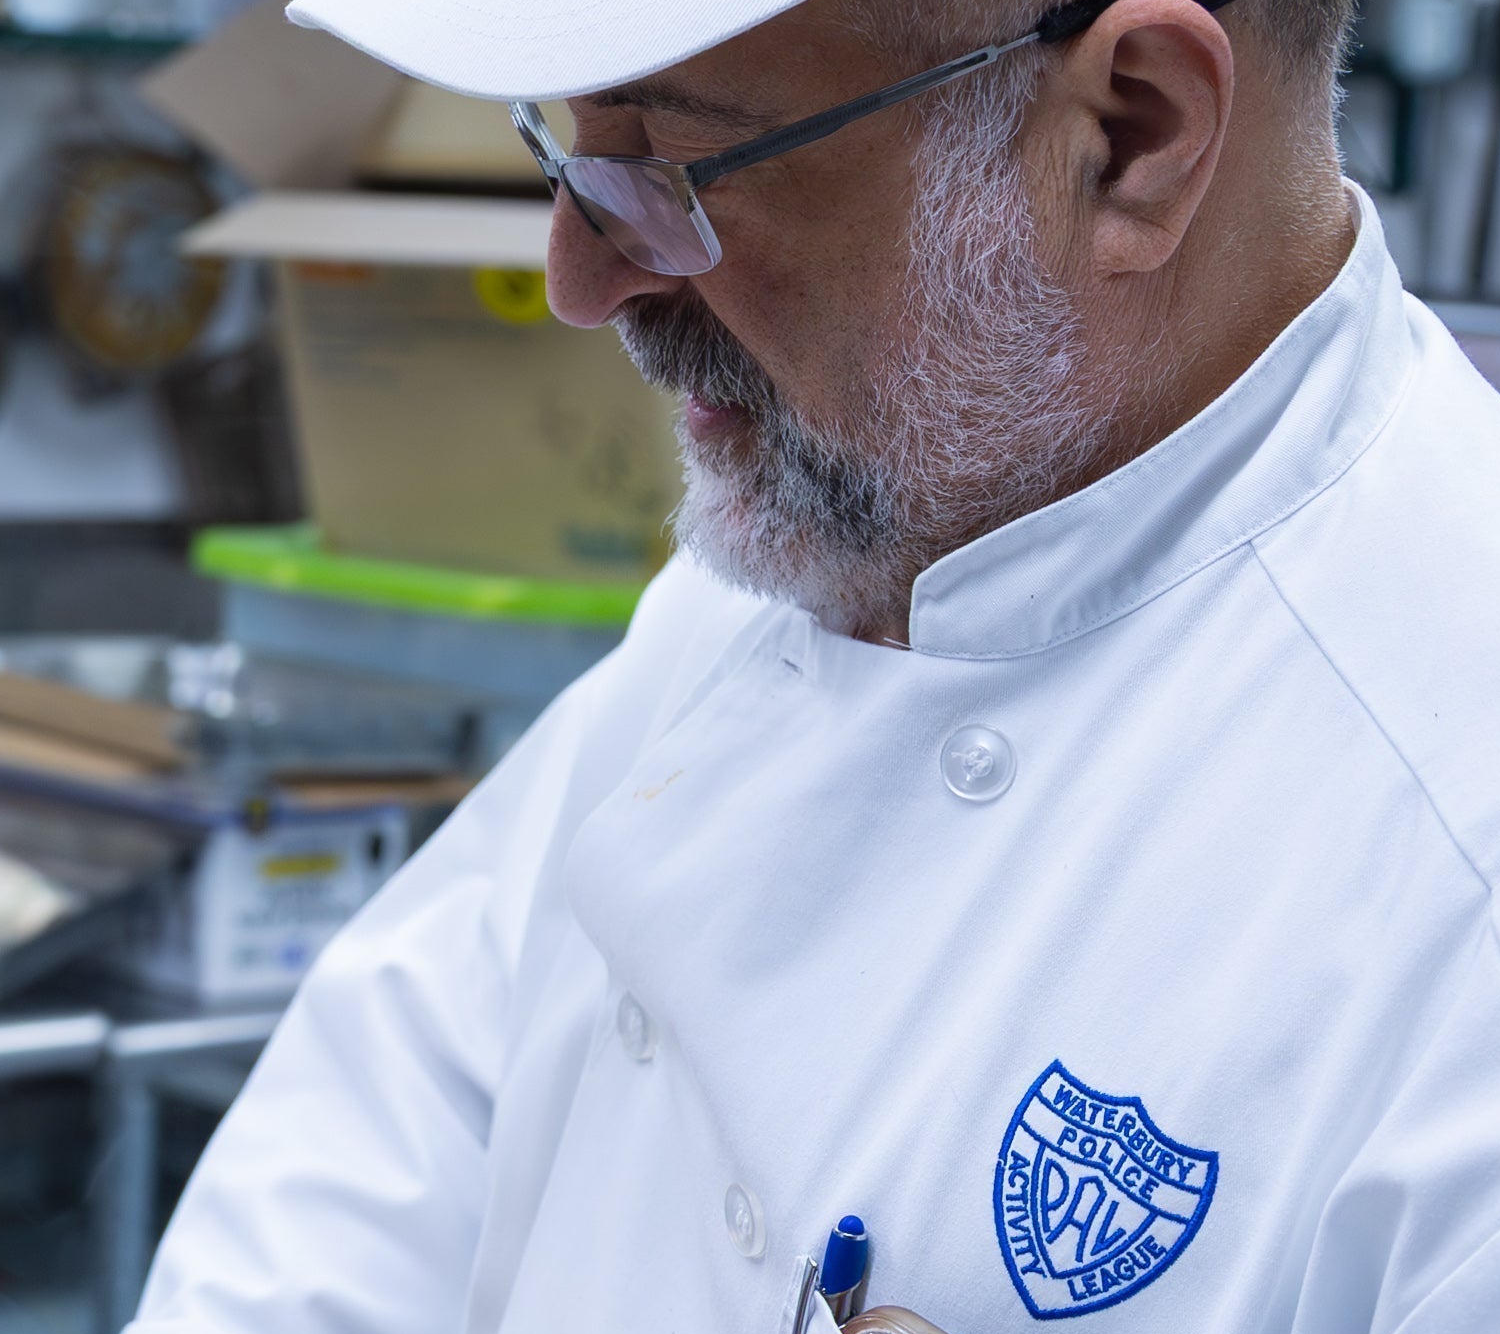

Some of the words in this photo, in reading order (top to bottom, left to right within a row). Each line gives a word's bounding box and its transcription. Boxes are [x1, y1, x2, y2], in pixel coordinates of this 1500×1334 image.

[1053, 1083, 1195, 1183] WATERBURY
[1057, 1126, 1160, 1202] POLICE
[1003, 1149, 1047, 1278] ACTIVITY
[1041, 1158, 1126, 1263] PAL
[1067, 1235, 1168, 1302] LEAGUE
